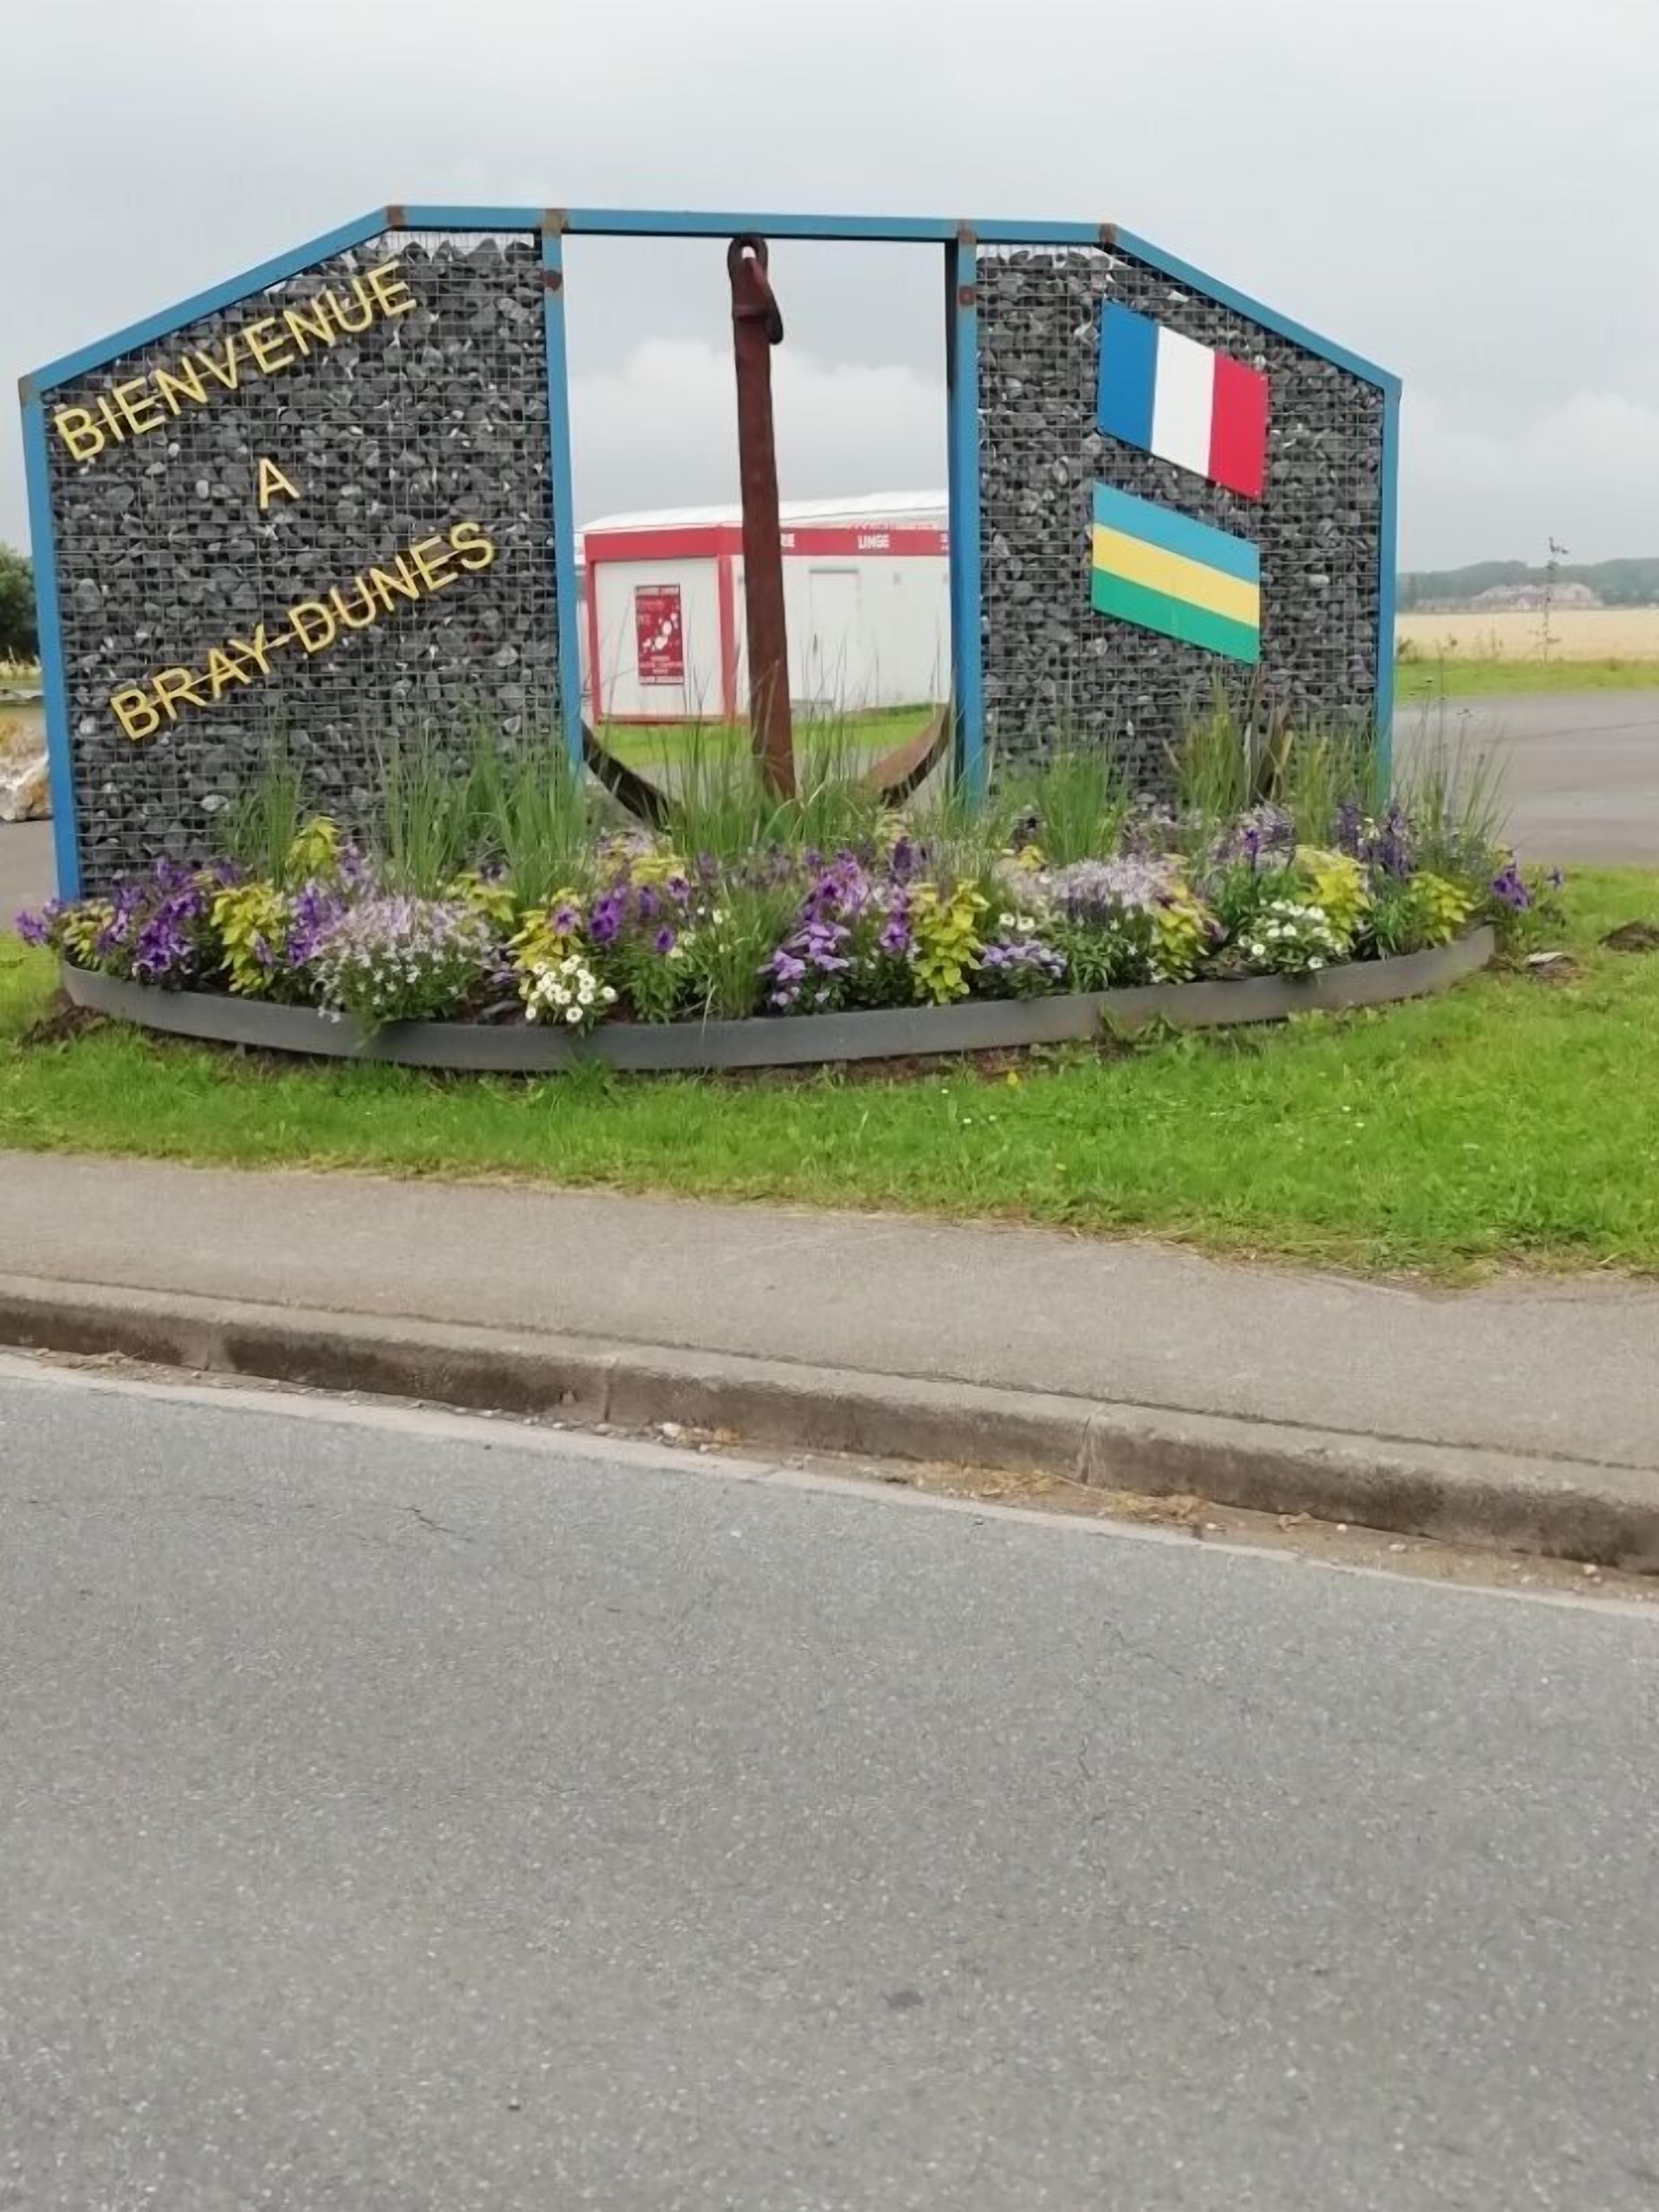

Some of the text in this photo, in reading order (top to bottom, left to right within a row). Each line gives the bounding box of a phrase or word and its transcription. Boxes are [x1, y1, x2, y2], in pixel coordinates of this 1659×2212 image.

[53, 260, 417, 462] BIENVENUE
[258, 457, 301, 510] A
[110, 522, 495, 741] BRAY-DUNES
